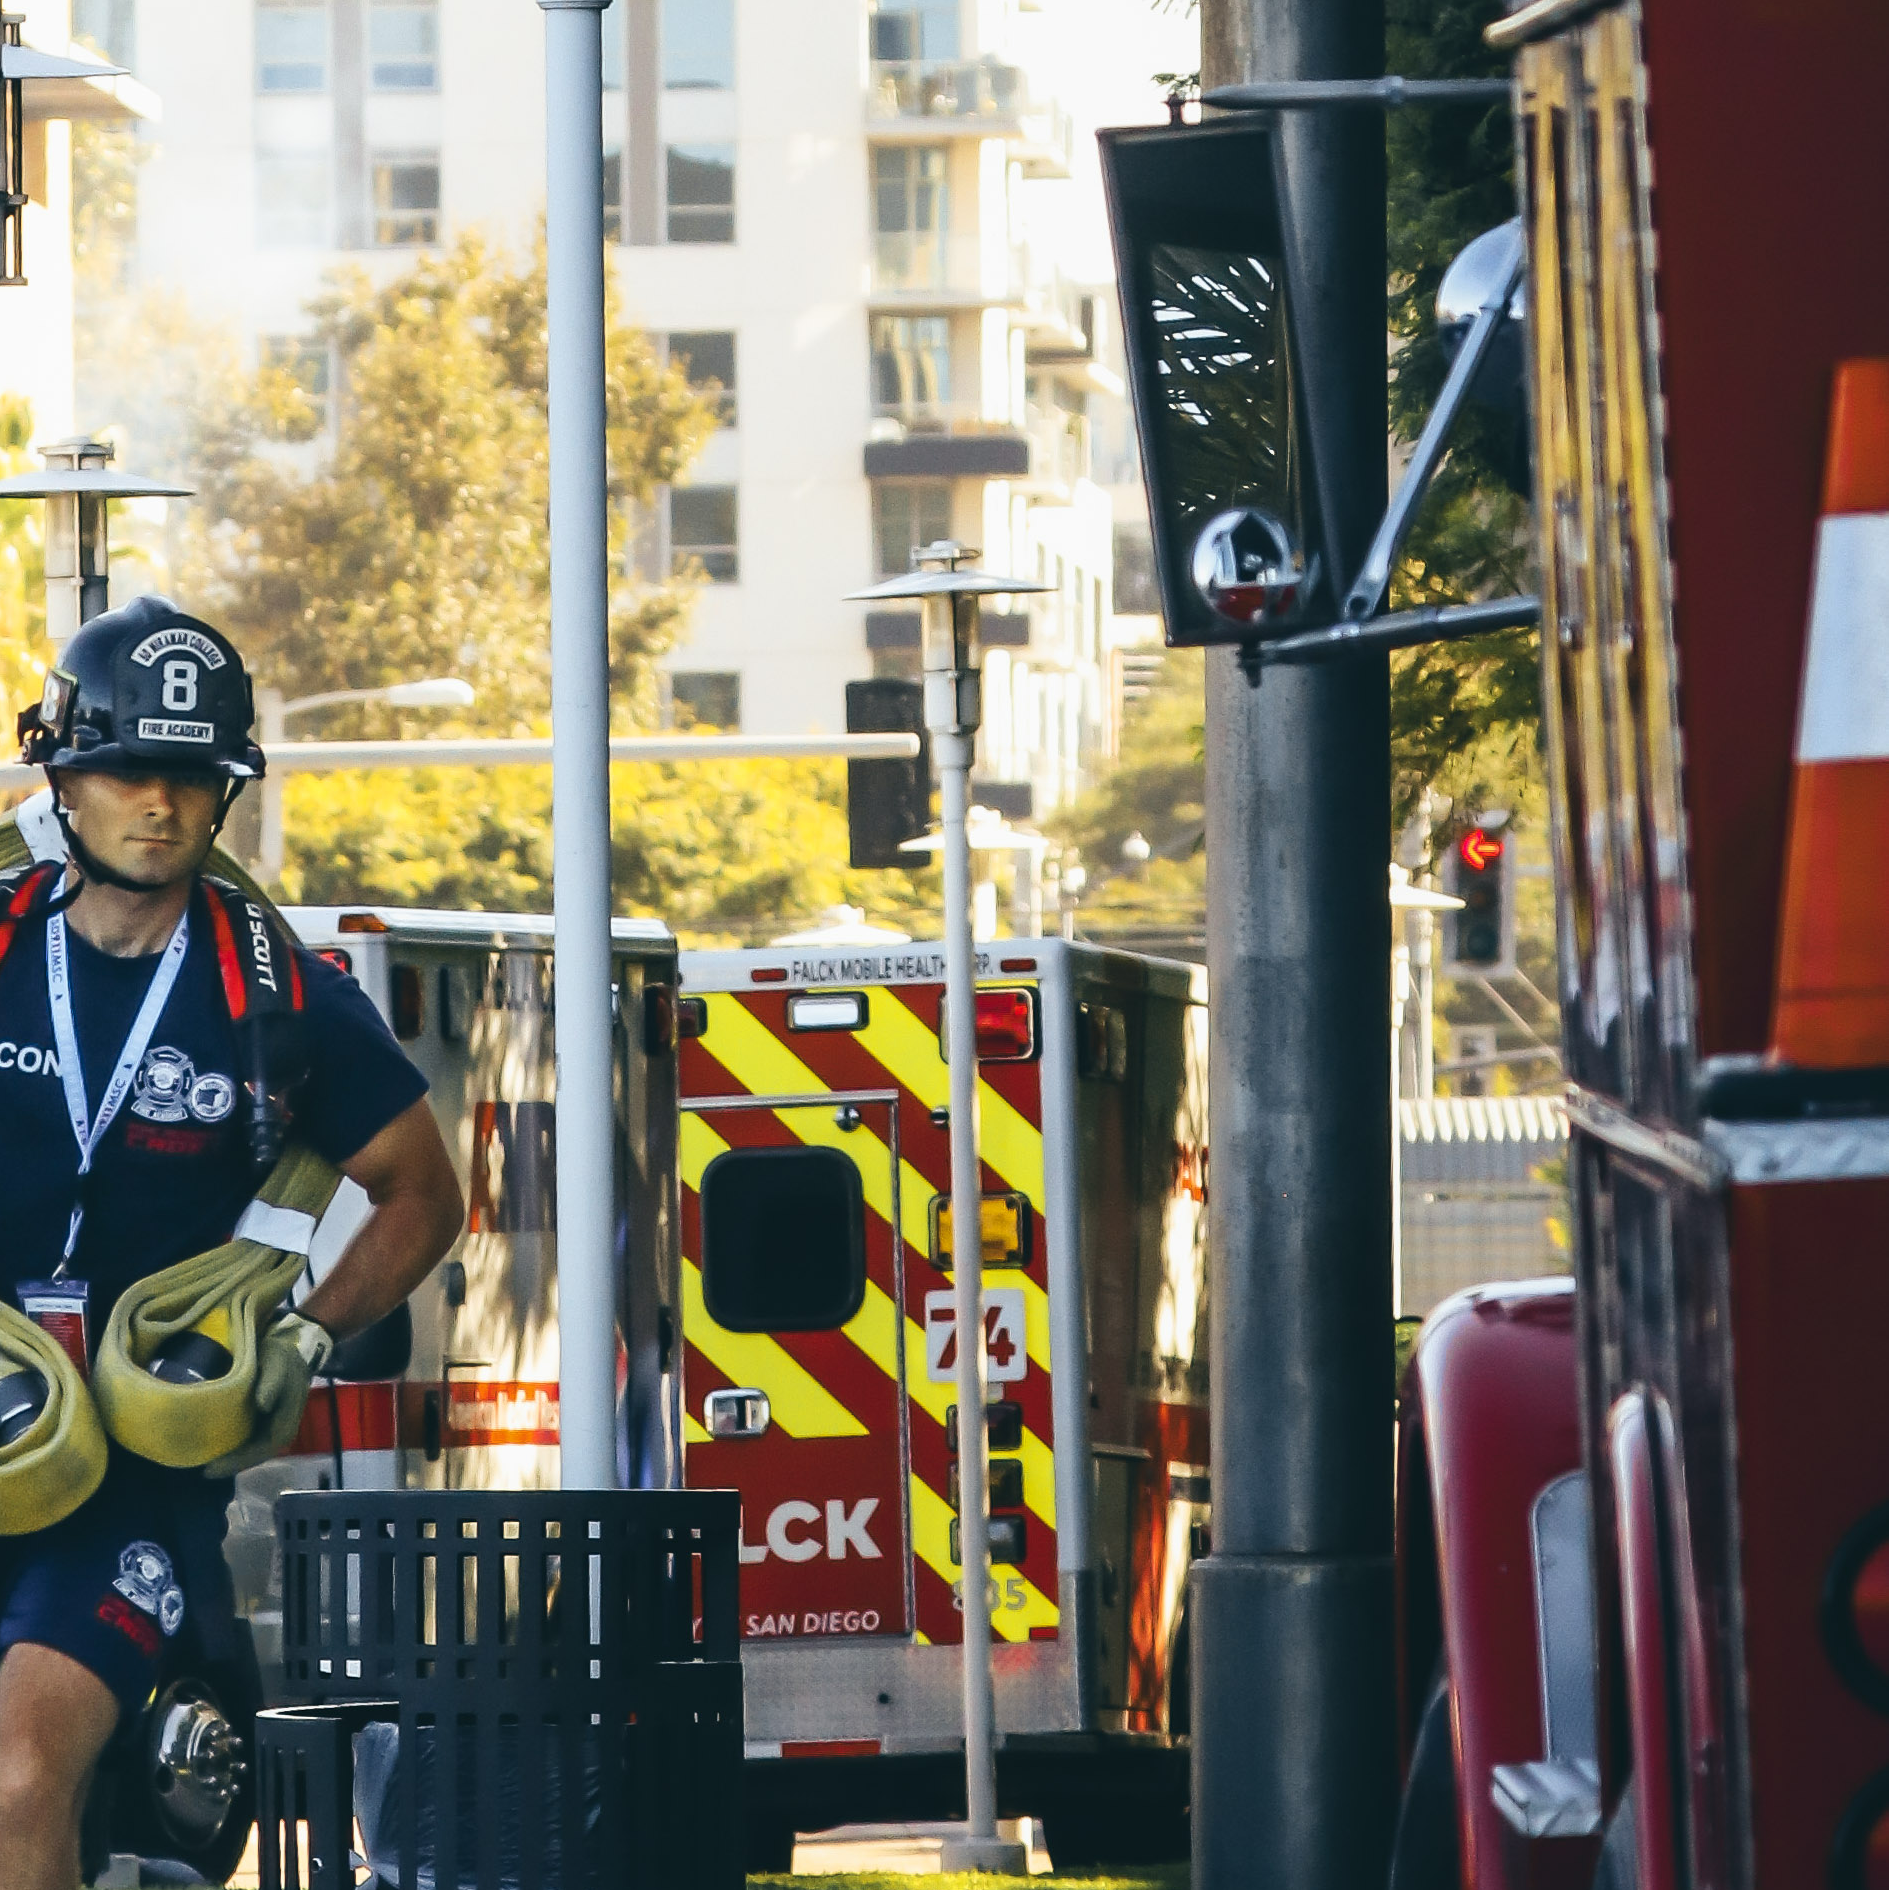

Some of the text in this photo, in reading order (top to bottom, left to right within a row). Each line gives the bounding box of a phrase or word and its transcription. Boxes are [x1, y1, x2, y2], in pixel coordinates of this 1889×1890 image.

[190, 634, 223, 668] COLLEGE
[162, 660, 198, 711] 8
[143, 722, 210, 737] FIRE ACADEMY
[249, 920, 278, 993] SCOTT
[792, 961, 837, 982] FALCK
[840, 957, 892, 980] MOBILE
[930, 1306, 1016, 1368] 74
[745, 1609, 880, 1636] SAN DIEGO
